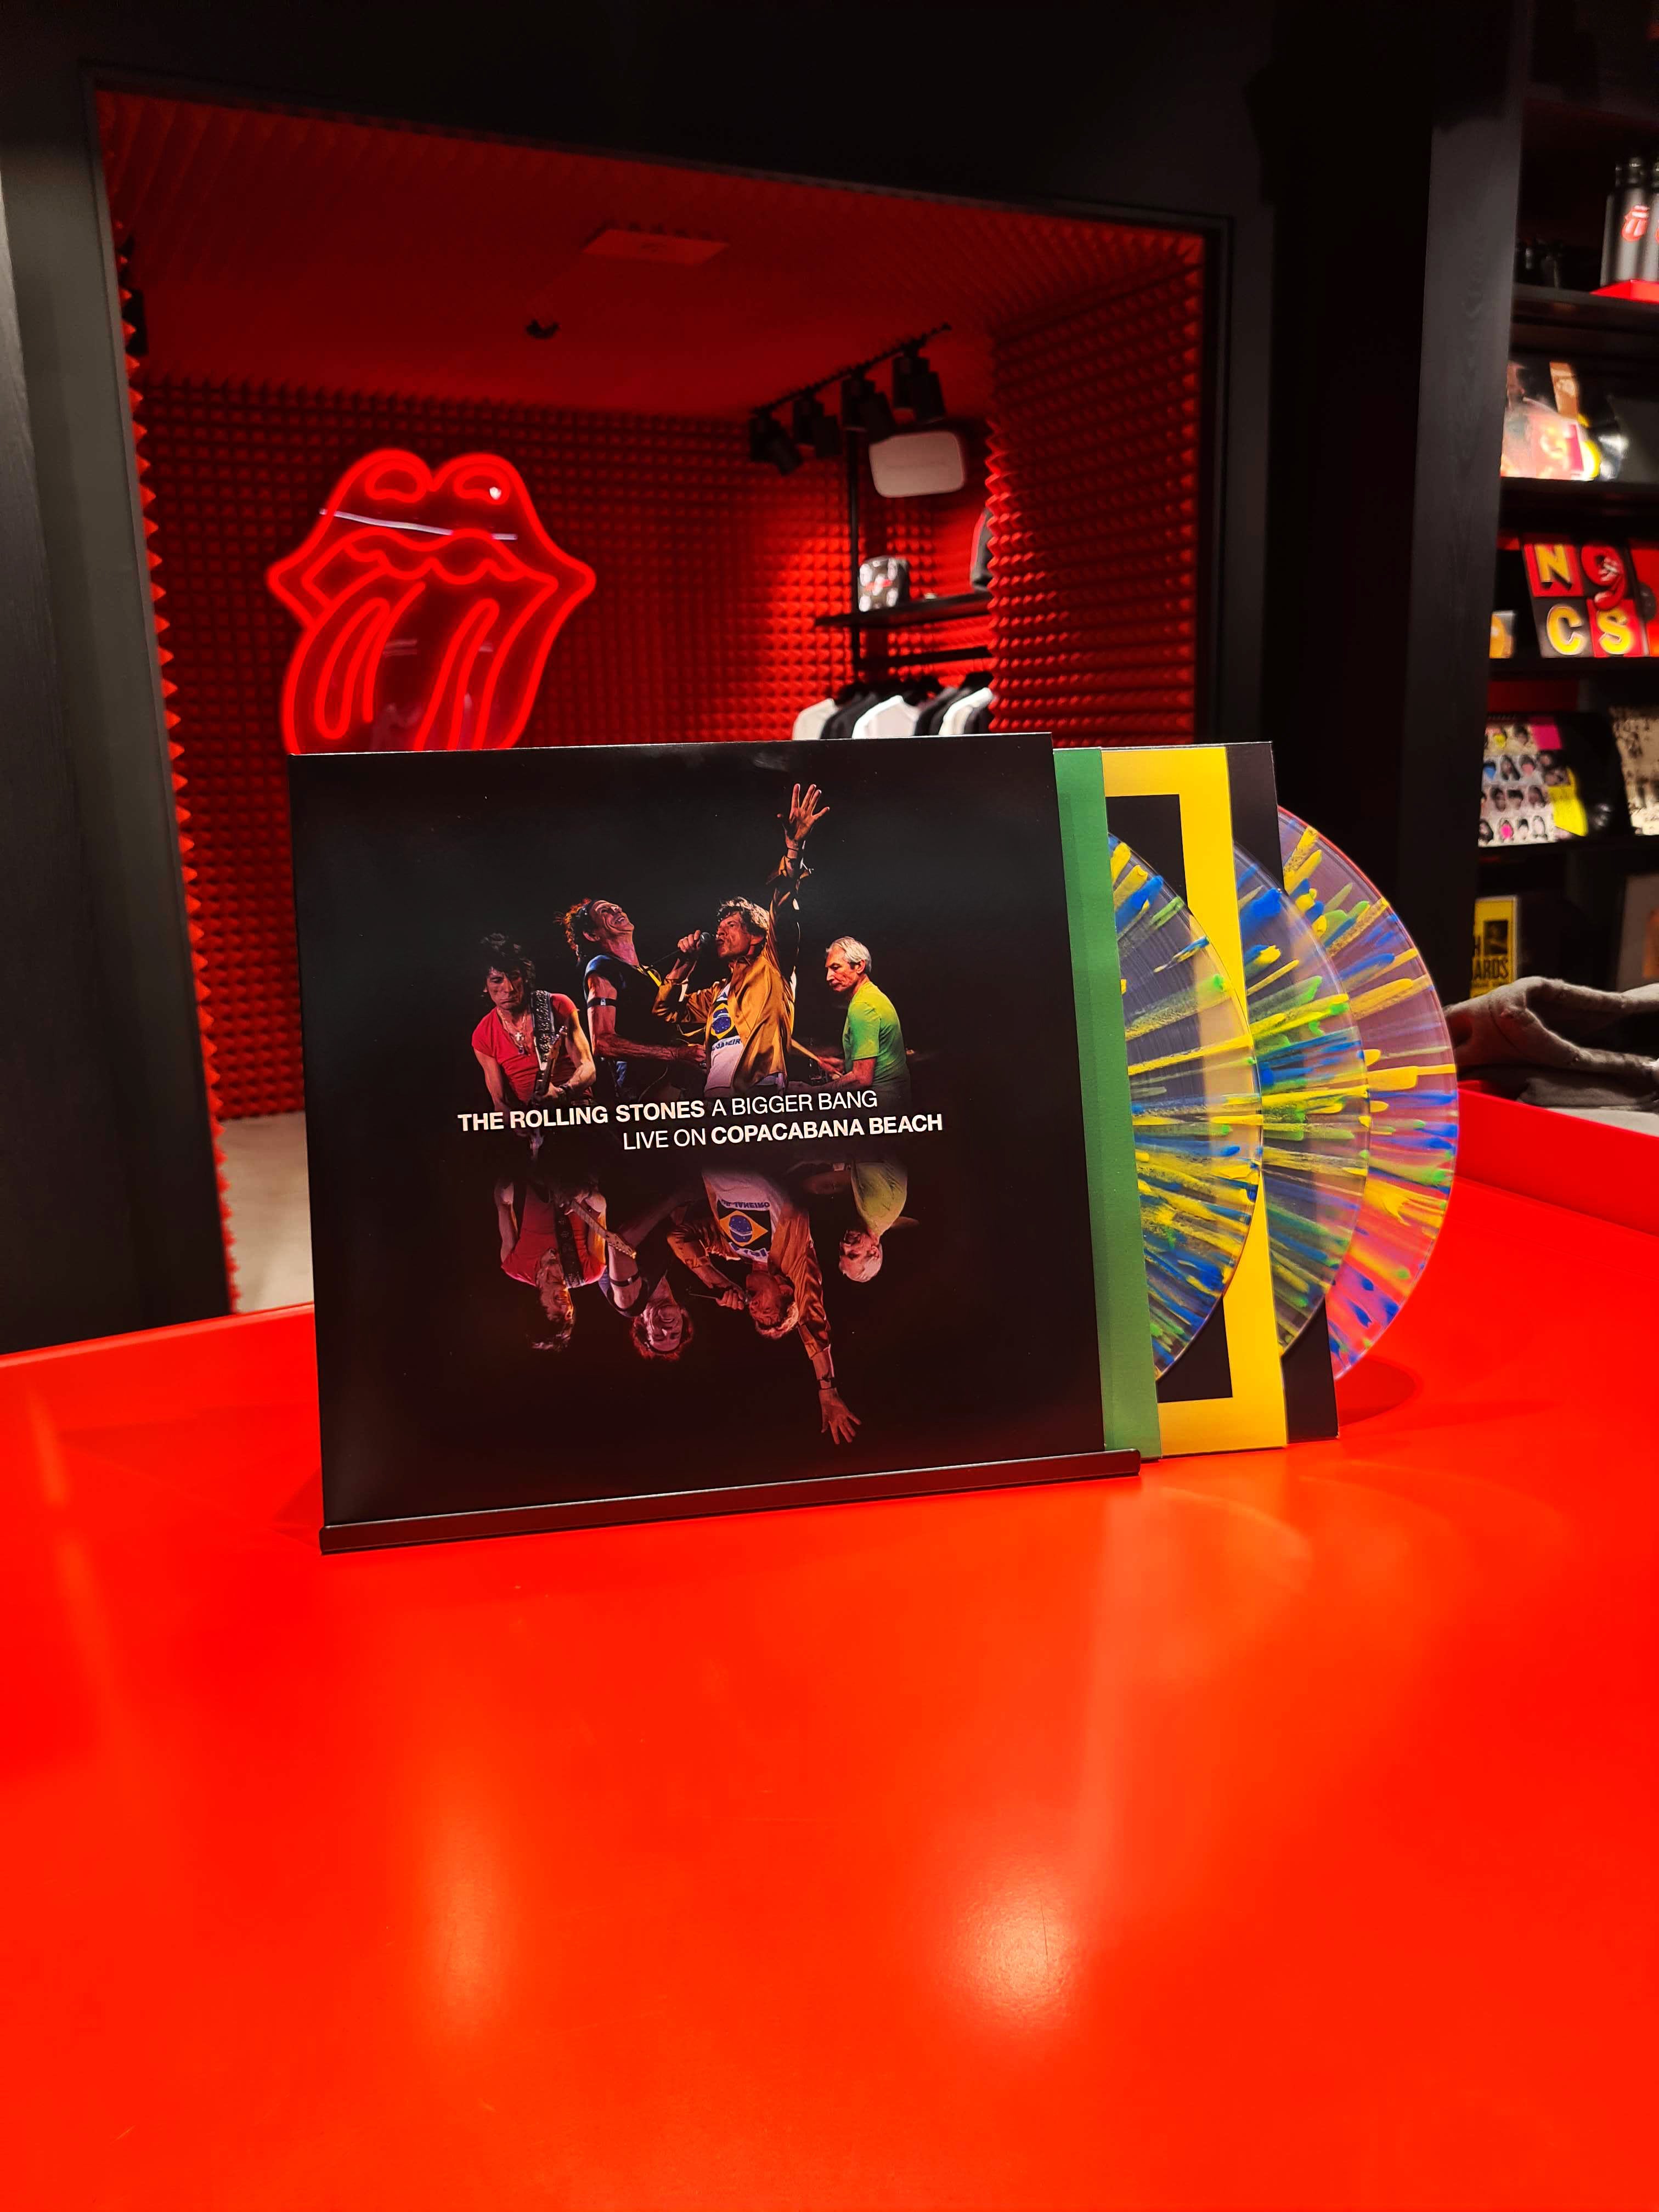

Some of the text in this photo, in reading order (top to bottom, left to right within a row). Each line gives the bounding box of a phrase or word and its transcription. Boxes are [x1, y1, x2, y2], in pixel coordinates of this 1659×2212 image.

[1472, 957, 1508, 979] ARDS
[457, 1090, 877, 1131] THE ROLLING STONES A BIGGER BANG
[623, 1113, 943, 1150] LIVE ON COPACABANA BEACH
